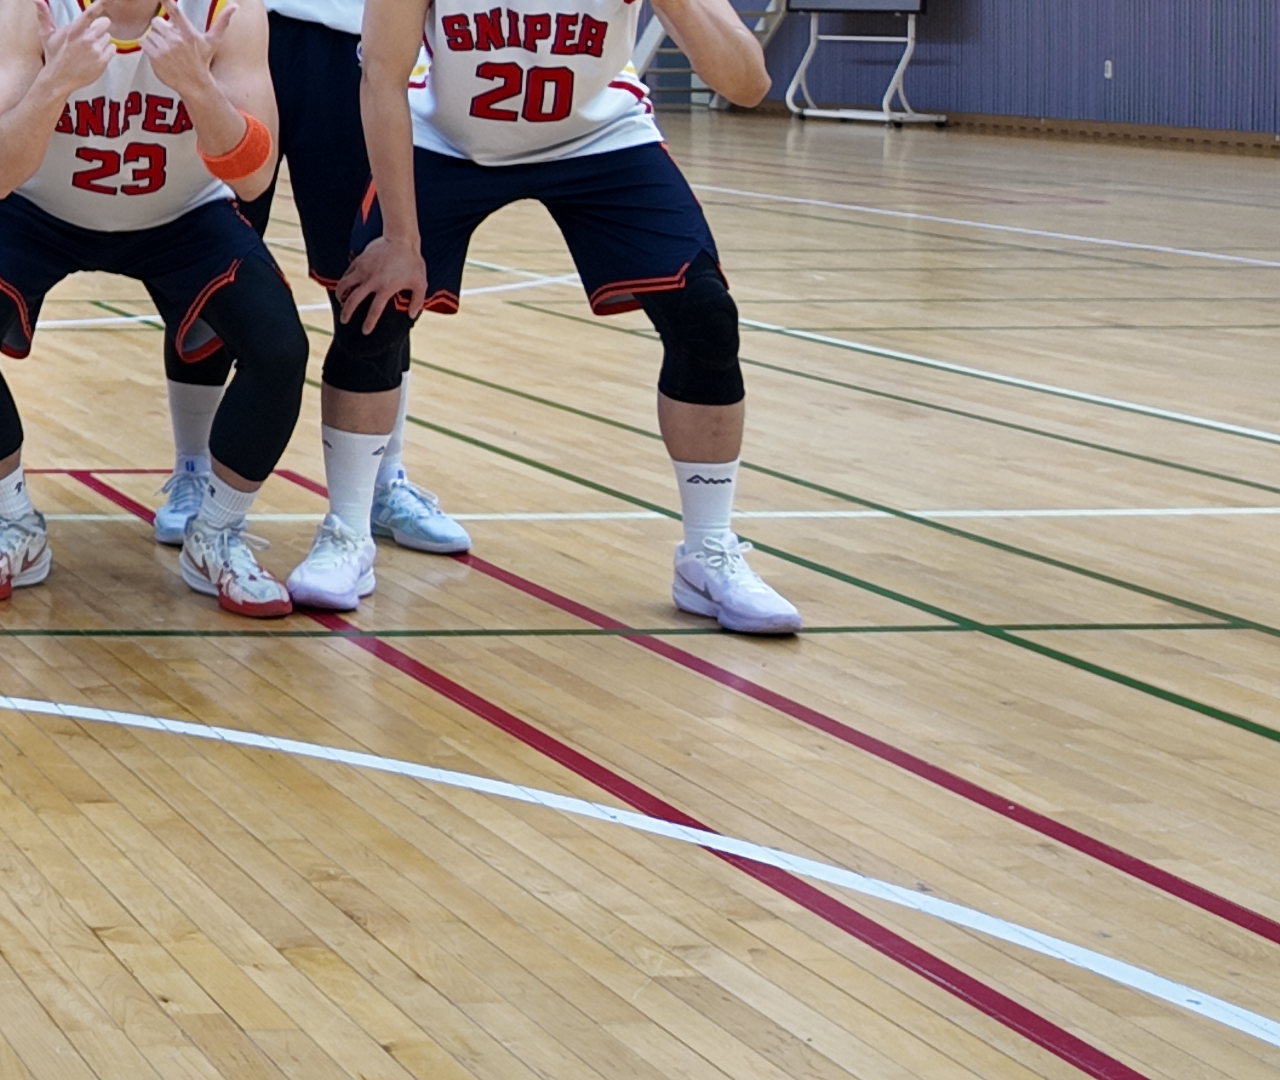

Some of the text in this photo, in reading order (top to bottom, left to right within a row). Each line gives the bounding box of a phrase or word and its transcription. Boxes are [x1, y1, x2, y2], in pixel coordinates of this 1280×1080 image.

[441, 7, 608, 58] SNIPER
[469, 61, 574, 123] 20
[71, 142, 167, 196] 23
